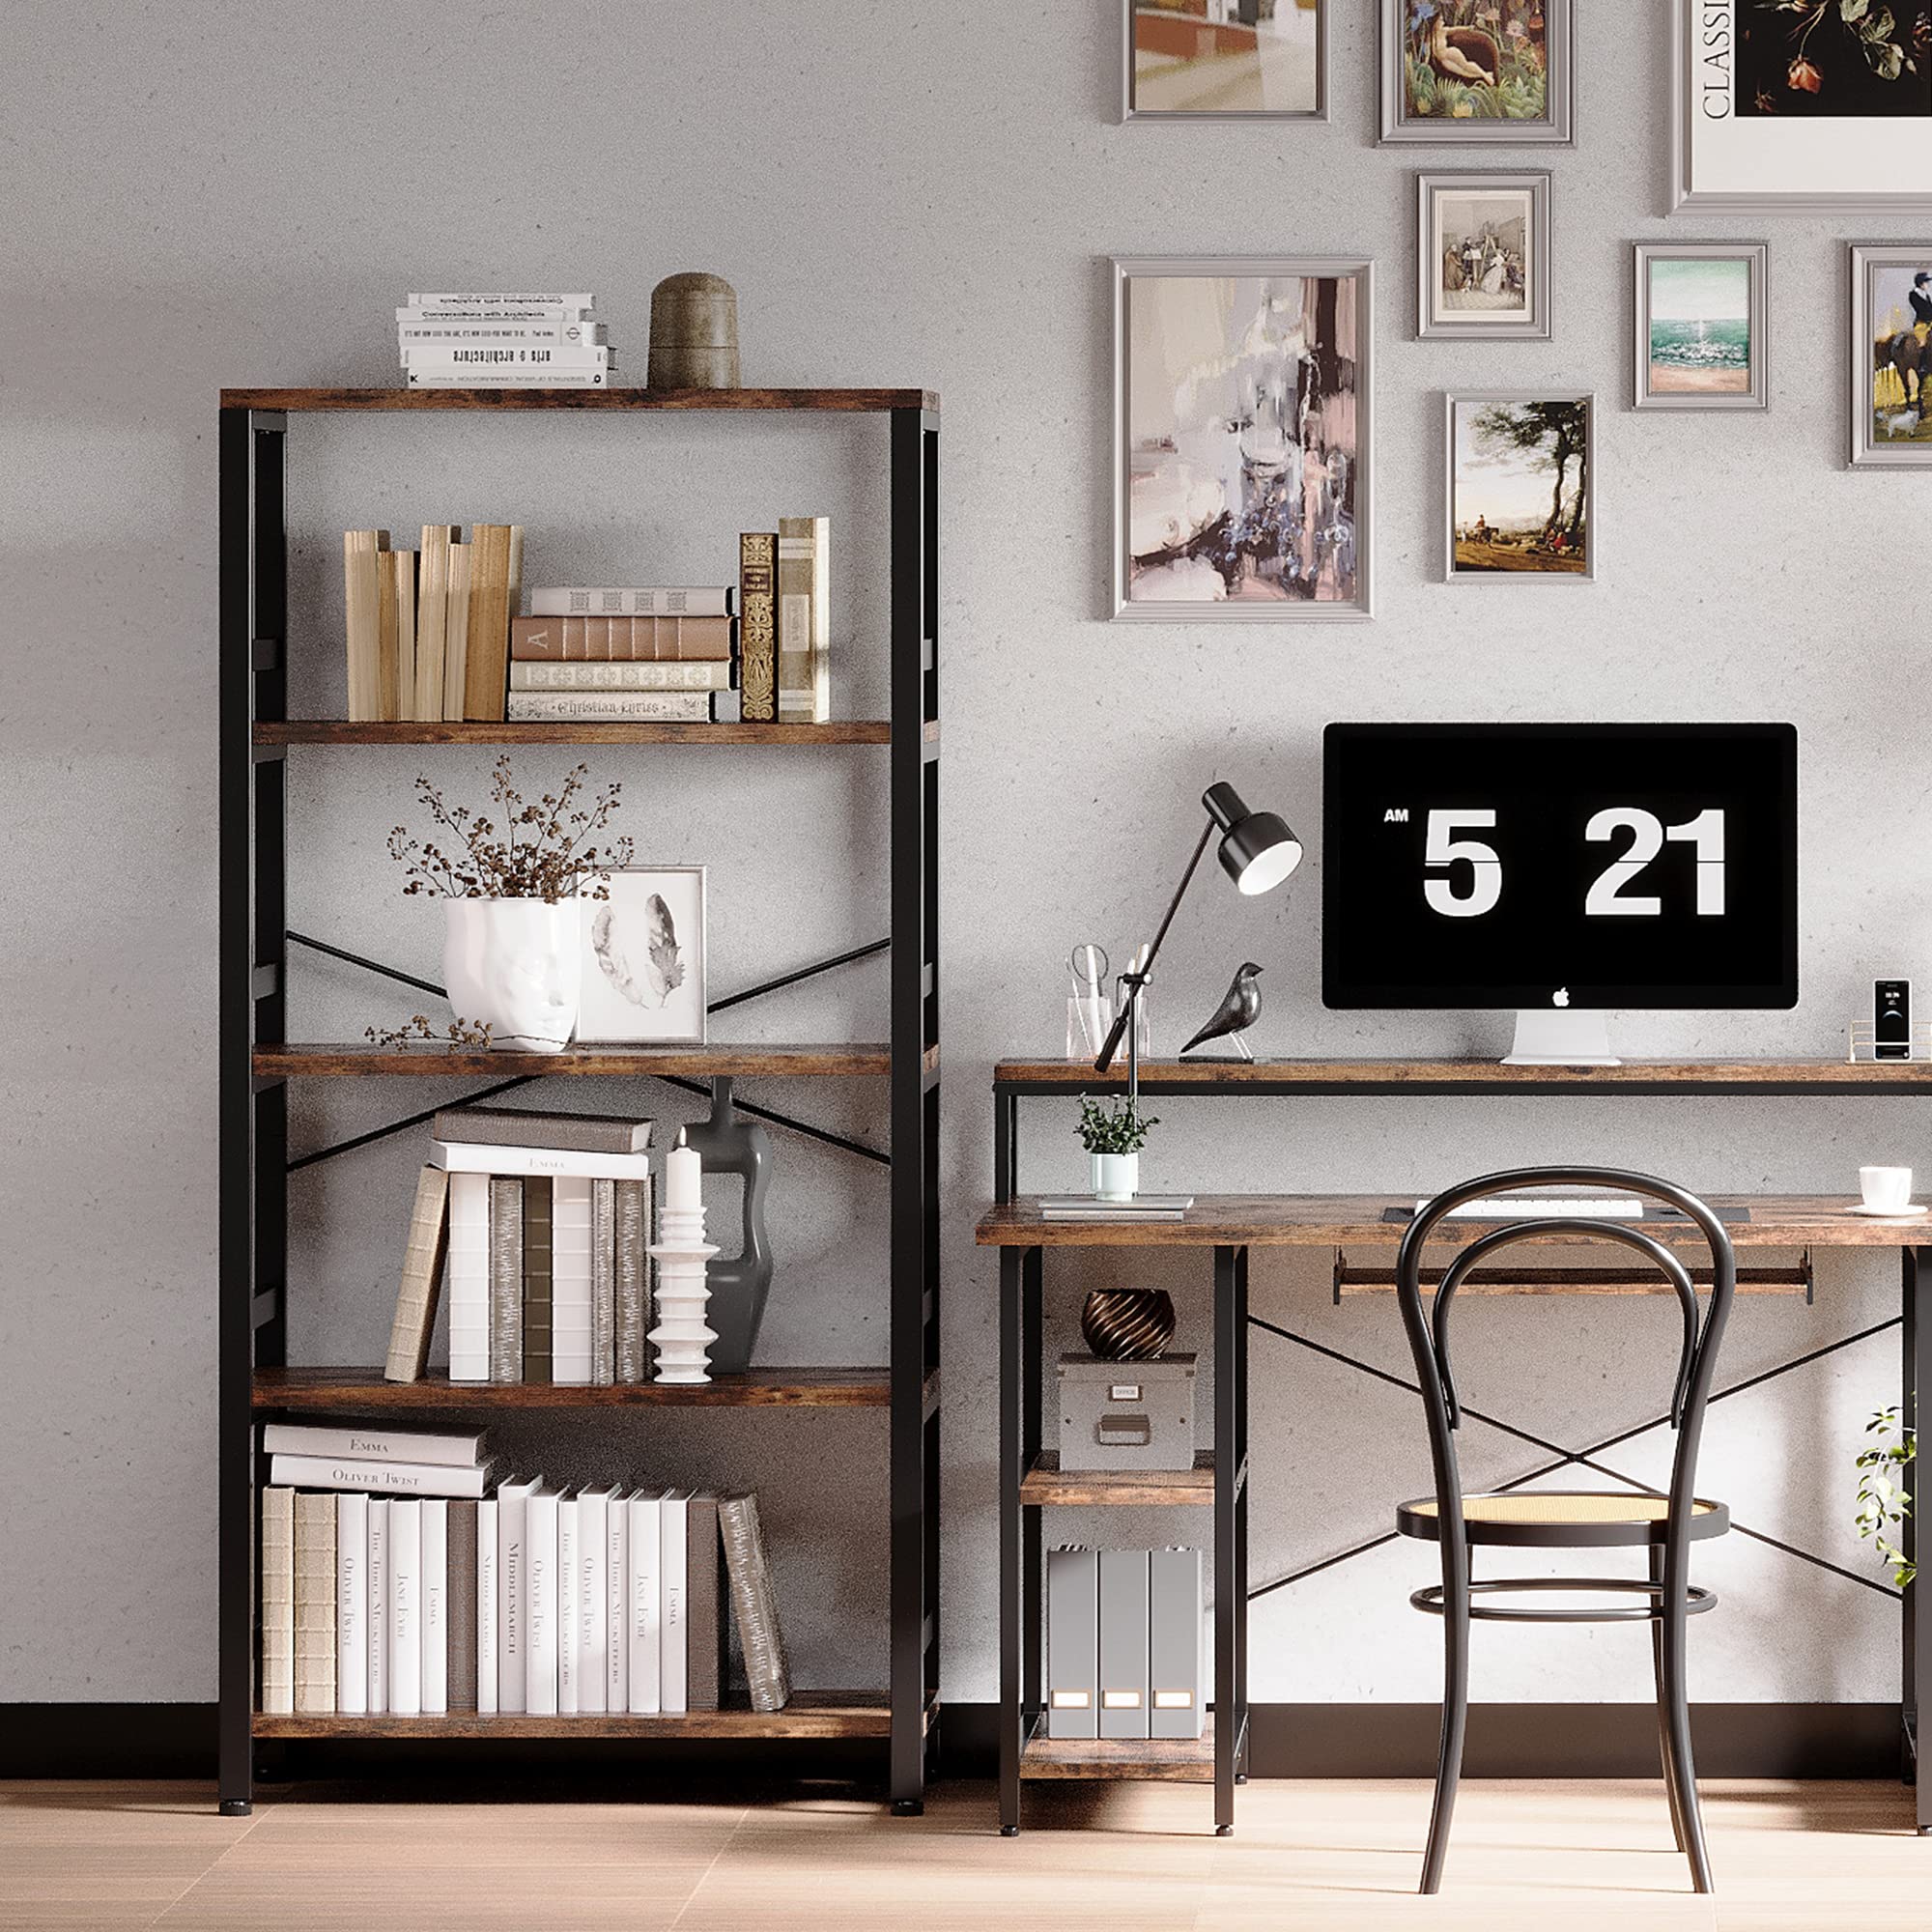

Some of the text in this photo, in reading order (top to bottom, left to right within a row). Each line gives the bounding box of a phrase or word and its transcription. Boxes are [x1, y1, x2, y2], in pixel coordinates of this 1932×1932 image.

[453, 350, 514, 364] architecture
[531, 350, 551, 363] arts
[1384, 808, 1725, 917] AM 5 21
[350, 1437, 389, 1453] EMMA
[332, 1467, 420, 1487] OLIVER TWIST
[396, 1573, 409, 1602] JANE
[508, 1543, 519, 1655] MIDDLEMARCH
[532, 1559, 545, 1607] OLIVER
[583, 1557, 596, 1605] OLIVER
[343, 1557, 355, 1647] OLIVER TWIST
[668, 1587, 679, 1627] EMMA
[637, 1607, 648, 1640] EYRE
